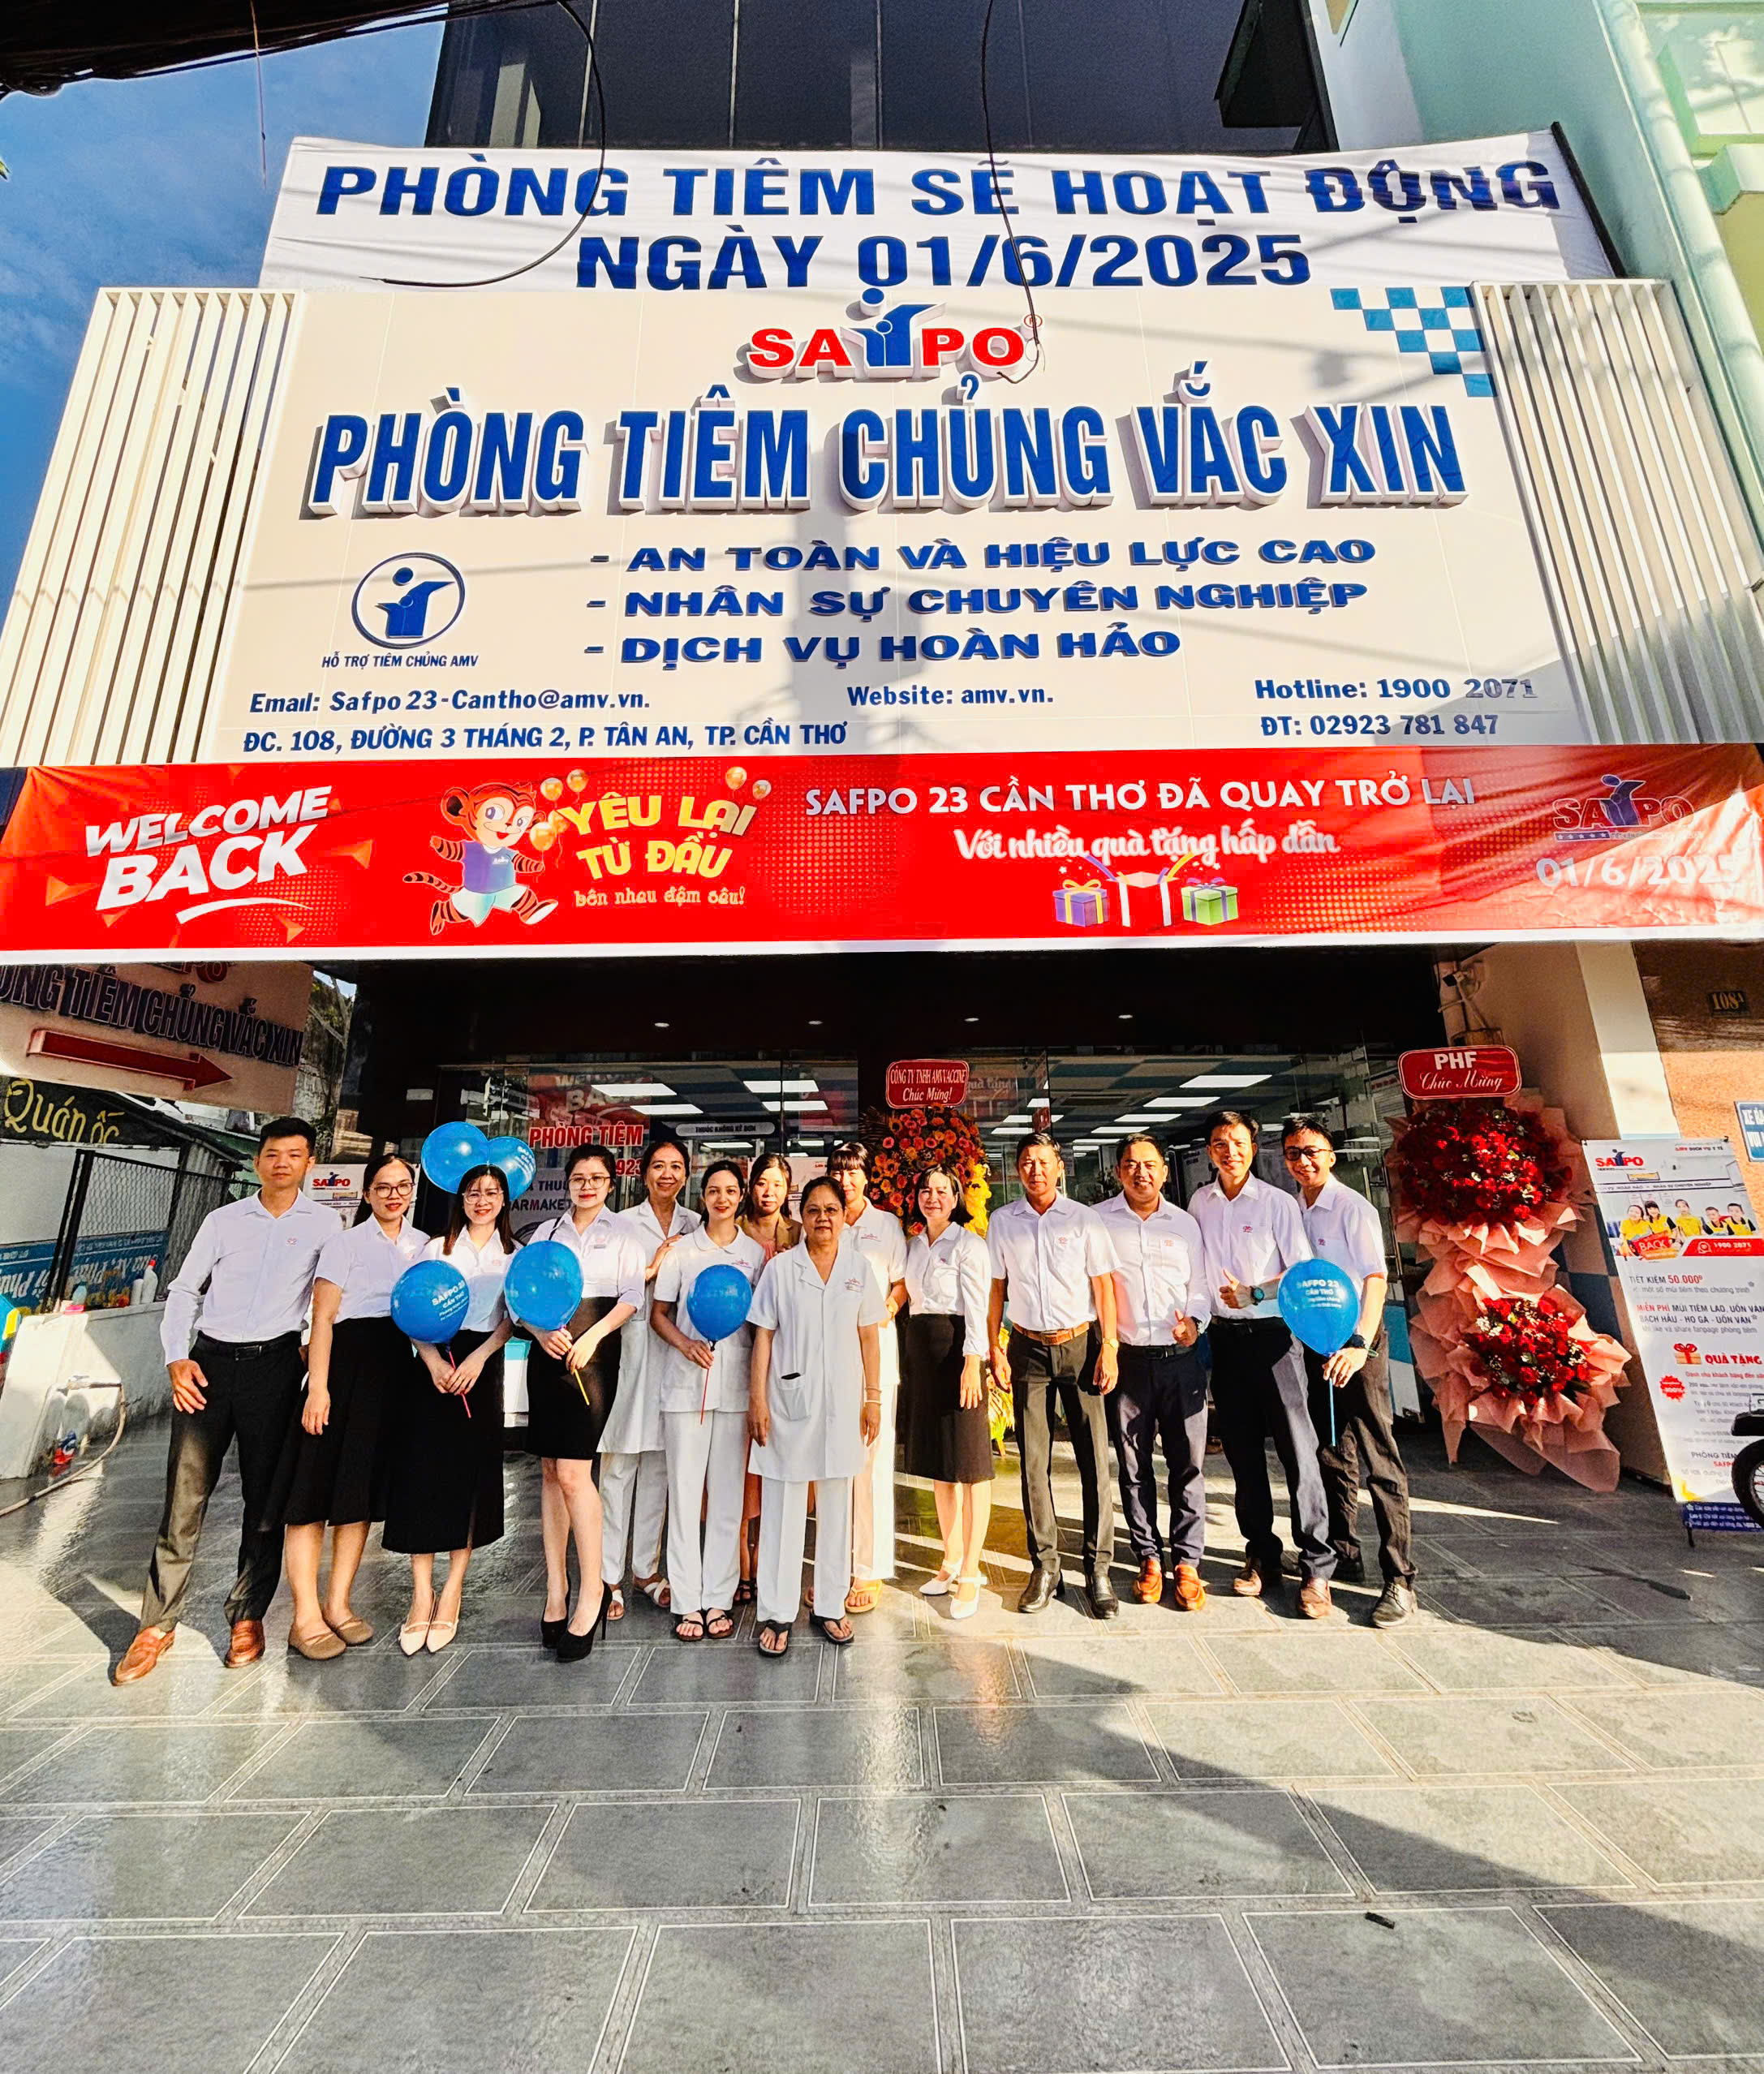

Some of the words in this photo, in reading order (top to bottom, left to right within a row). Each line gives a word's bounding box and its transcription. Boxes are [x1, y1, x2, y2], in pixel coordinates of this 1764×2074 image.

[317, 153, 629, 217] PHÒNG
[663, 157, 876, 217] TIÊM
[911, 159, 1020, 217] SẼ
[1053, 169, 1276, 226] HOẠT
[1305, 159, 1562, 224] ĐỘNG
[577, 224, 824, 290] NGÀY
[858, 233, 1311, 289] 01/6/2025
[310, 387, 587, 511] PHÒNG
[617, 385, 811, 510] TIÊM
[839, 372, 1115, 510] CHỦNG
[1131, 360, 1290, 506] VẮC
[1305, 402, 1469, 506] XIN
[626, 547, 708, 573] AN
[725, 540, 880, 573] TOÀN
[898, 538, 968, 570] VÀ
[983, 536, 1111, 572] HIỆU
[1128, 536, 1241, 571] LỰC
[1258, 539, 1377, 565] CAO
[624, 585, 785, 618] NHÂN
[810, 586, 892, 622] SỰ
[906, 578, 1140, 614] CHUYÊN
[1152, 578, 1369, 615] NGHIỆP
[321, 650, 340, 669] HỖ
[343, 652, 369, 669] TRỢ
[372, 651, 402, 669] TIÊM
[405, 649, 448, 669] CHỦNG
[450, 653, 480, 669] AMV
[621, 637, 763, 672] DỊCH
[785, 635, 860, 669] VỤ
[878, 626, 1041, 664] HOÀN
[1056, 622, 1181, 659] HẢO
[249, 691, 321, 714] Email:
[847, 685, 954, 708] Website:
[960, 686, 1054, 705] amv.vn.
[1254, 677, 1368, 703] Hotline:
[1376, 677, 1452, 701] 1900
[1464, 677, 1538, 700] 2071
[243, 730, 283, 755] ĐC.
[290, 729, 343, 755] 108,
[350, 721, 432, 753] ĐƯỜNG
[440, 727, 456, 750] 3
[463, 720, 544, 750] THÁNG
[549, 726, 573, 751] 2,
[578, 725, 593, 748] P.
[604, 720, 648, 747] TÂN
[655, 723, 695, 751] AN,
[705, 722, 737, 747] TP.
[742, 715, 791, 747] CẦN
[798, 721, 850, 746] THƠ
[1260, 715, 1303, 738] ĐT:
[1309, 713, 1392, 737] 02923
[1399, 714, 1446, 737] 781
[1452, 713, 1500, 736] 847
[806, 787, 918, 815] SAFPO
[929, 786, 968, 813] 23
[979, 775, 1055, 812] CẦN
[1065, 779, 1147, 811] THƠ
[1157, 777, 1211, 809] ĐÃ
[1220, 779, 1325, 811] QUAY
[1335, 770, 1409, 807] TRỞ
[1421, 777, 1475, 810] LẠI
[84, 785, 334, 858] WELCOME
[557, 792, 662, 836] YÊU
[678, 795, 758, 838] LẠI
[575, 837, 631, 880] TỪ
[645, 832, 734, 878] ĐẦU
[953, 828, 1007, 859] Với
[1009, 824, 1091, 860] nhiều
[1091, 828, 1151, 866] quà
[1149, 826, 1220, 867] tặng
[1220, 817, 1277, 863] hấp
[1283, 819, 1342, 854] dẫn
[96, 823, 325, 910] BACK
[1535, 856, 1743, 889] 01/6/2025
[615, 887, 657, 904] nhau
[664, 885, 701, 907] đậm
[708, 885, 746, 905] sâu!
[67, 966, 143, 1030] TIÊM
[142, 983, 228, 1048] CHỦNG
[266, 1022, 305, 1067] XIN
[890, 1065, 906, 1084] CÔNG
[907, 1069, 914, 1084] TY
[916, 1069, 931, 1084] TNHH
[1434, 1051, 1477, 1069] PHF
[902, 1086, 924, 1102] Chúc
[926, 1086, 953, 1104] Mừng!
[1420, 1072, 1452, 1091] Chúc
[1455, 1070, 1503, 1093] Mừng
[3, 1078, 87, 1143] Quán
[529, 1121, 593, 1149] PHÒNG
[599, 1121, 643, 1147] TIÊM
[1638, 1239, 1665, 1251] BACK
[1704, 1353, 1729, 1365] QUÀ
[1730, 1353, 1762, 1366] TẶNG
